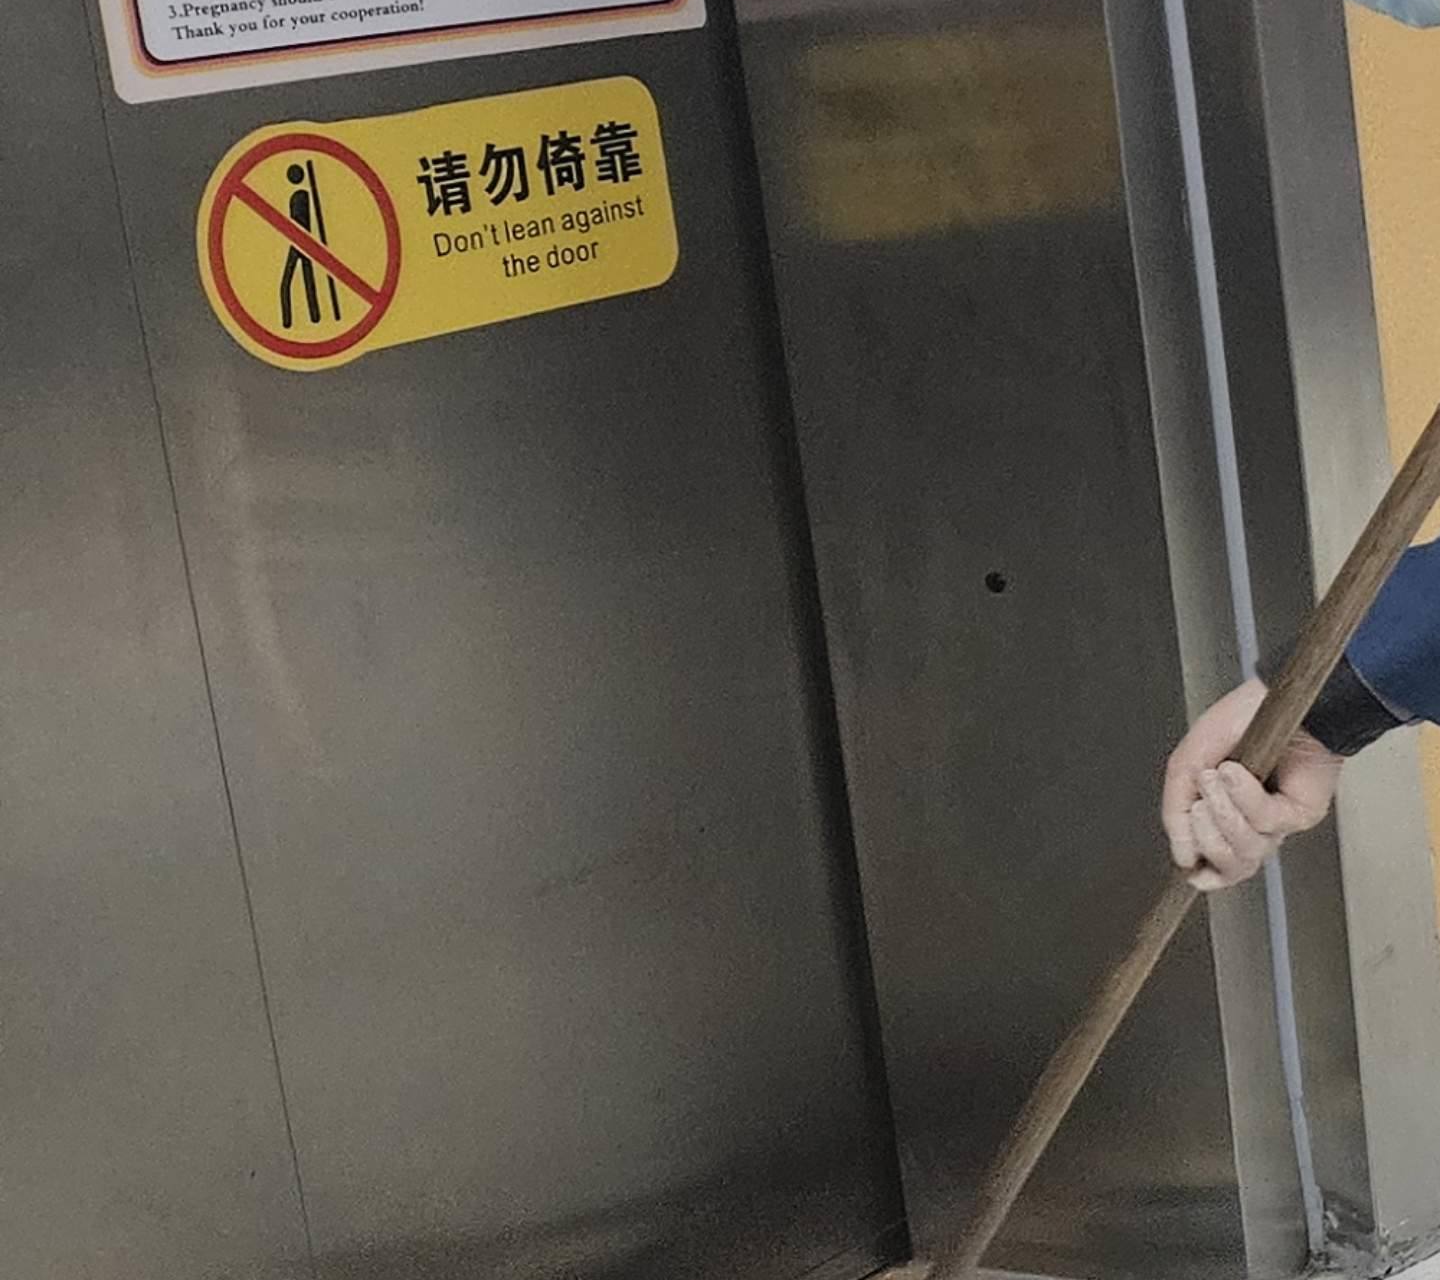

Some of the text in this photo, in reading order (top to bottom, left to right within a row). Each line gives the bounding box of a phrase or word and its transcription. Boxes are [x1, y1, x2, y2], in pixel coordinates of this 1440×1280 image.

[171, 22, 225, 42] Thank
[228, 20, 258, 41] you
[262, 15, 286, 32] for
[289, 10, 328, 32] your
[416, 120, 643, 218] 请勿倚靠
[433, 195, 645, 257] Don't lean against
[502, 240, 600, 278] the door
